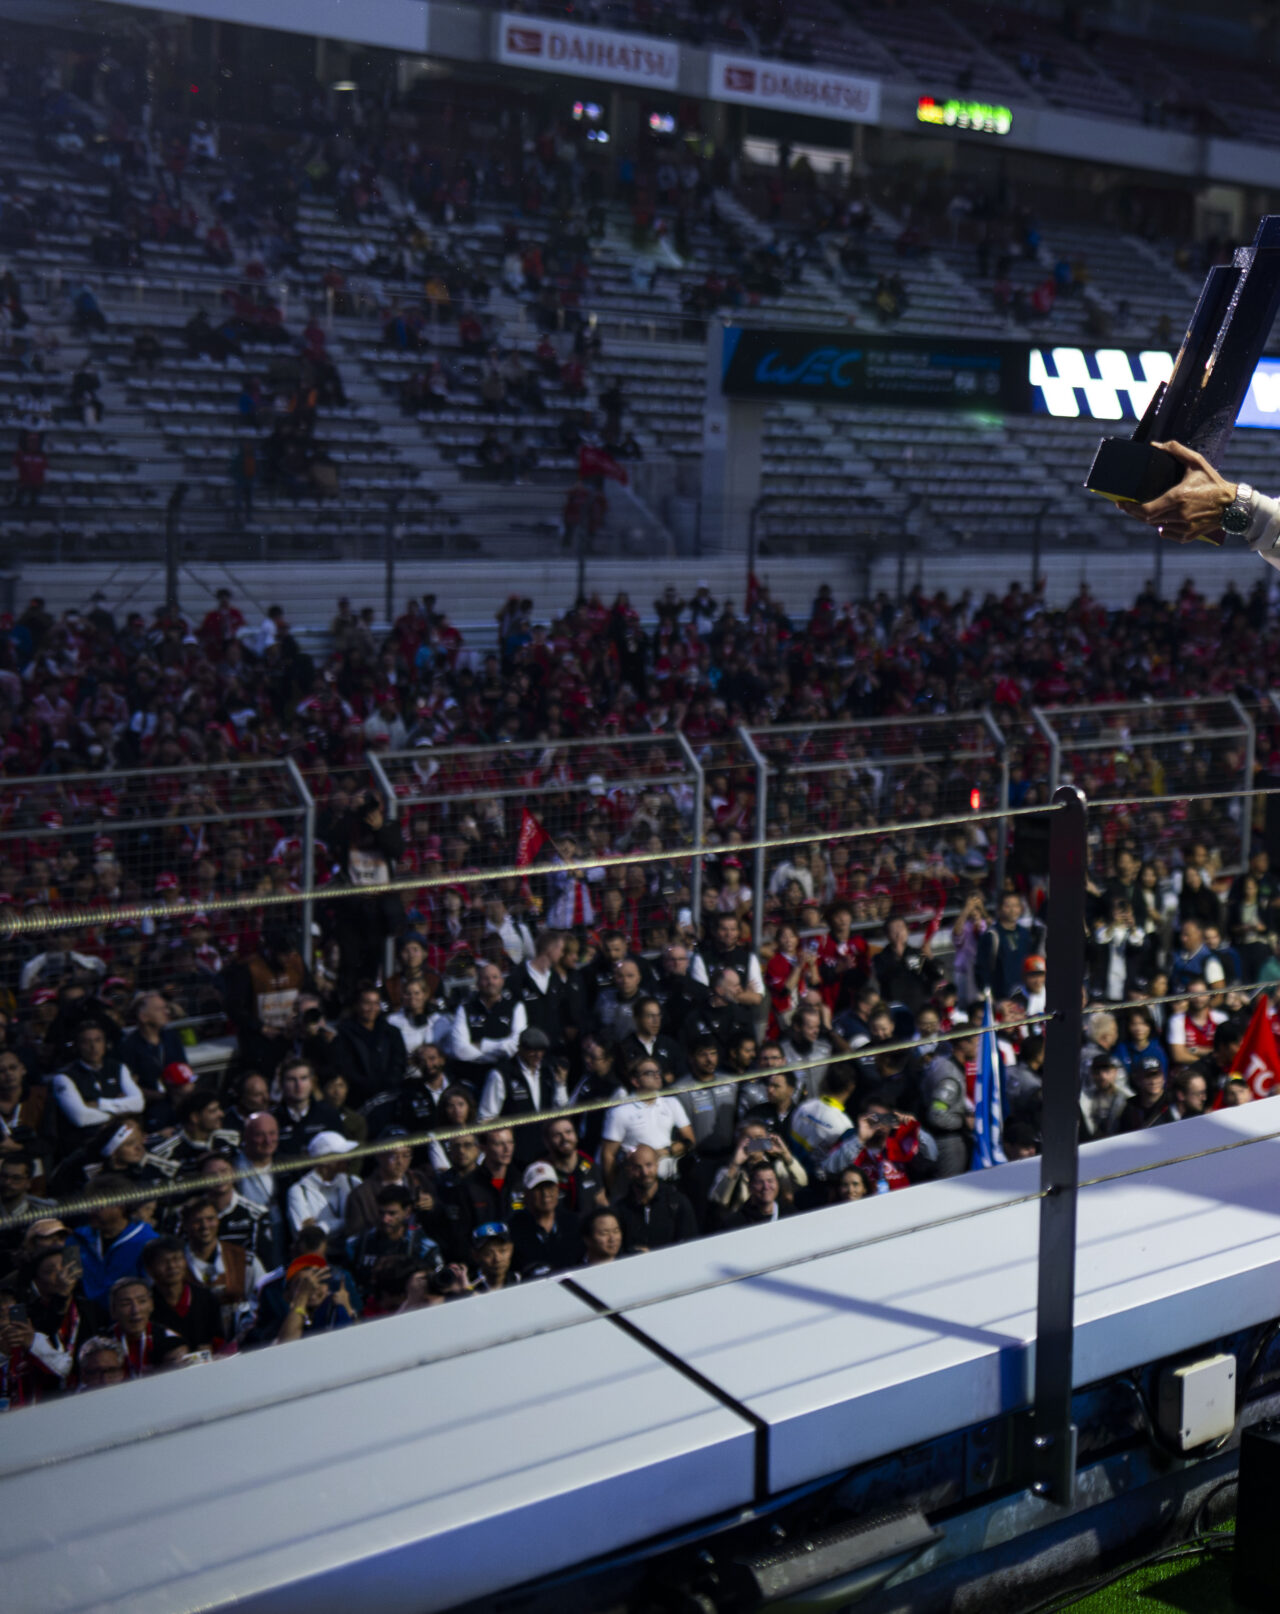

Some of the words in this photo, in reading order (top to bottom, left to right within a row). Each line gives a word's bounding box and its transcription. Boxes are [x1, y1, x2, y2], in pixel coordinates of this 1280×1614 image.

[548, 33, 674, 80] DAIHATSU
[761, 72, 872, 114] DAIHATSU
[755, 345, 862, 387] WEC
